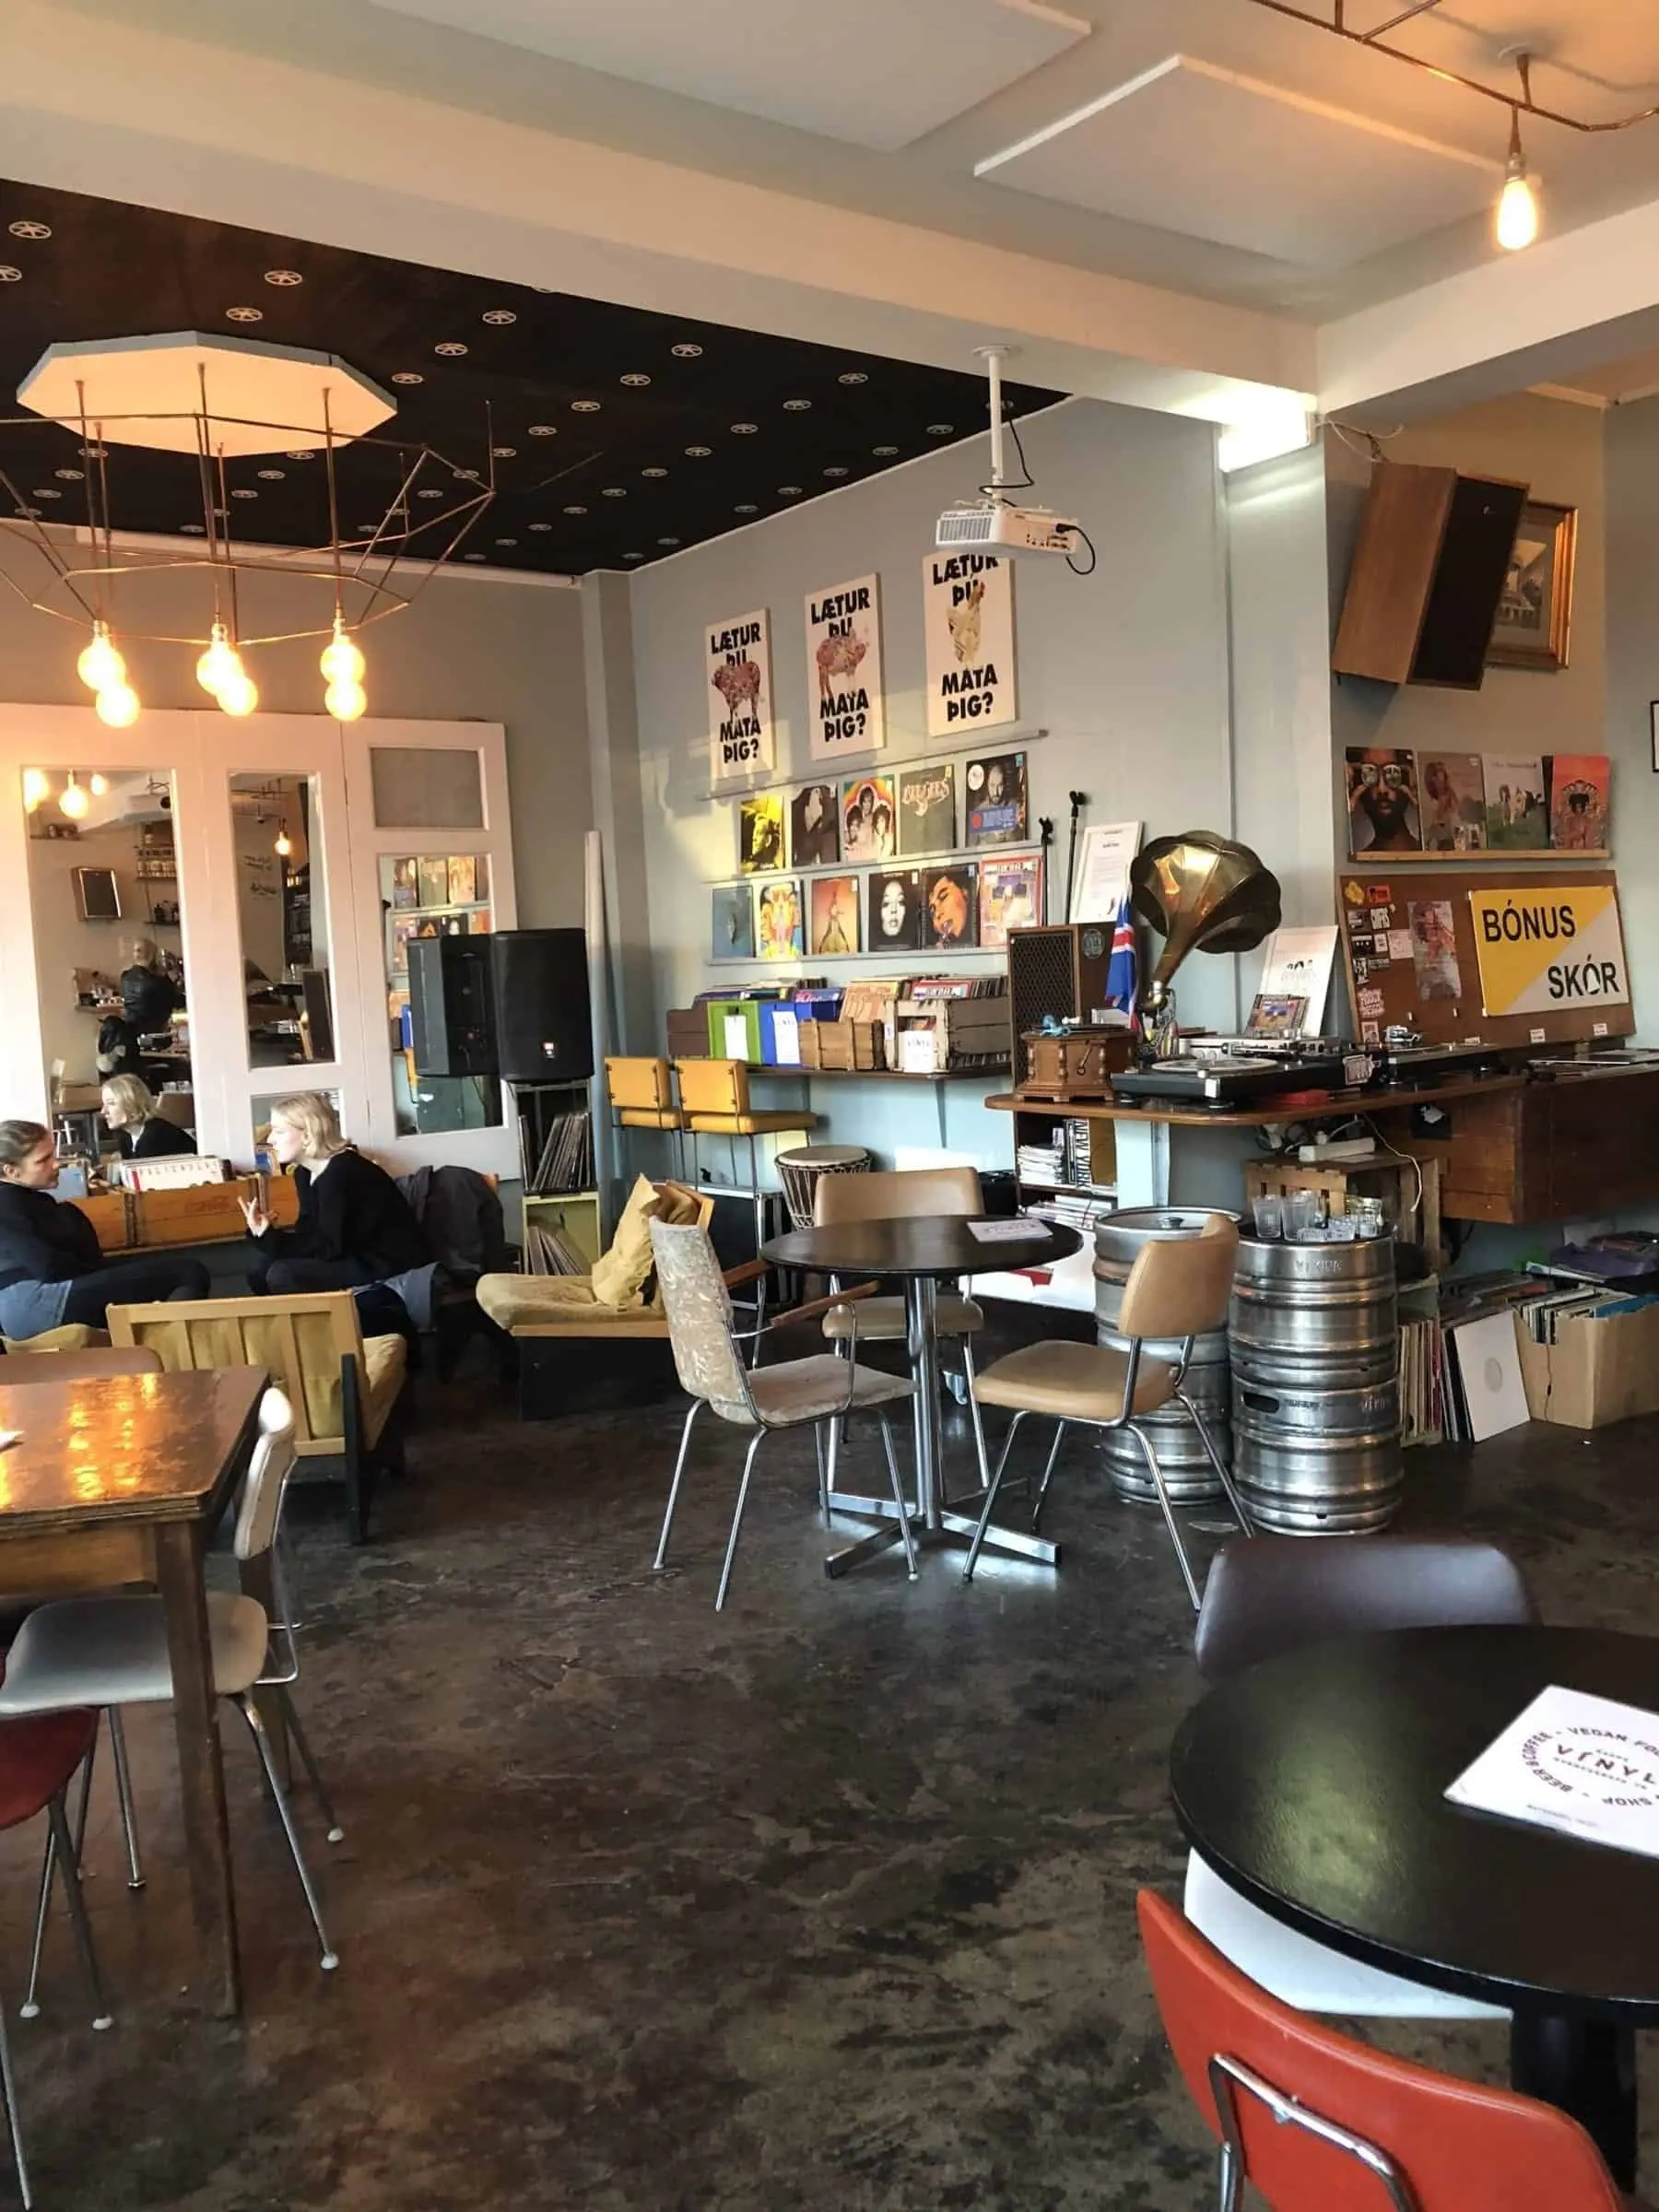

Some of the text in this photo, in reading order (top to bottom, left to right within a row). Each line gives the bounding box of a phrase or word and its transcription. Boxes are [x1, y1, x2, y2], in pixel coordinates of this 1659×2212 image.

[933, 554, 999, 585] LÆTUR
[811, 587, 870, 625] LÆTUR
[711, 622, 761, 654] LÆTUR
[942, 663, 998, 697] MATA
[820, 688, 869, 719] MATA
[720, 717, 761, 742] MATA
[1482, 899, 1576, 942] BÓNUS
[1547, 953, 1620, 999] SKÓR
[1075, 1119, 1091, 1188] NEW YORK
[1567, 1726, 1629, 1742] VEGAN
[1557, 1743, 1657, 1785] VINYL
